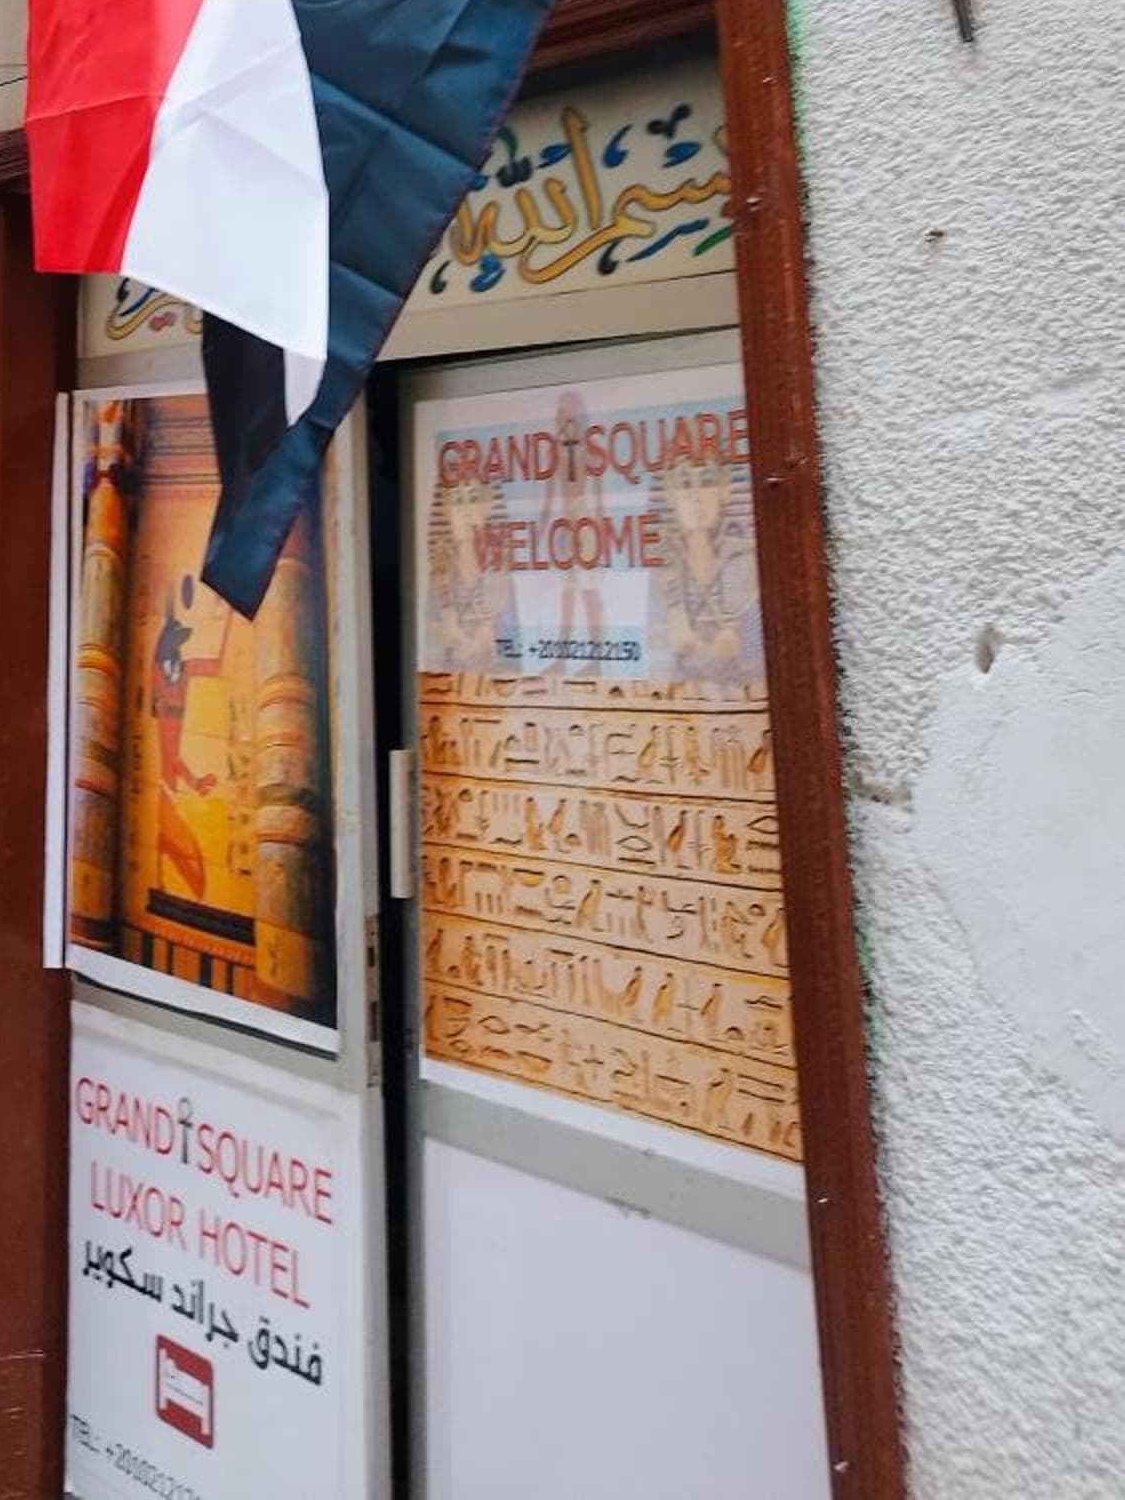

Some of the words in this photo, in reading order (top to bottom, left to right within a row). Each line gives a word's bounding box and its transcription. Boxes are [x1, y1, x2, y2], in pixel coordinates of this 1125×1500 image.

[437, 430, 559, 487] GRAND
[584, 409, 750, 484] SQUARE
[475, 514, 667, 572] WELCOME
[75, 1076, 174, 1157] GRAND
[196, 1122, 334, 1226] SQUARE
[90, 1160, 188, 1252] LUXOR
[198, 1207, 311, 1310] HOTEL
[82, 1240, 164, 1303] سكوير
[171, 1279, 240, 1349] جراند
[248, 1315, 323, 1386] فندق
